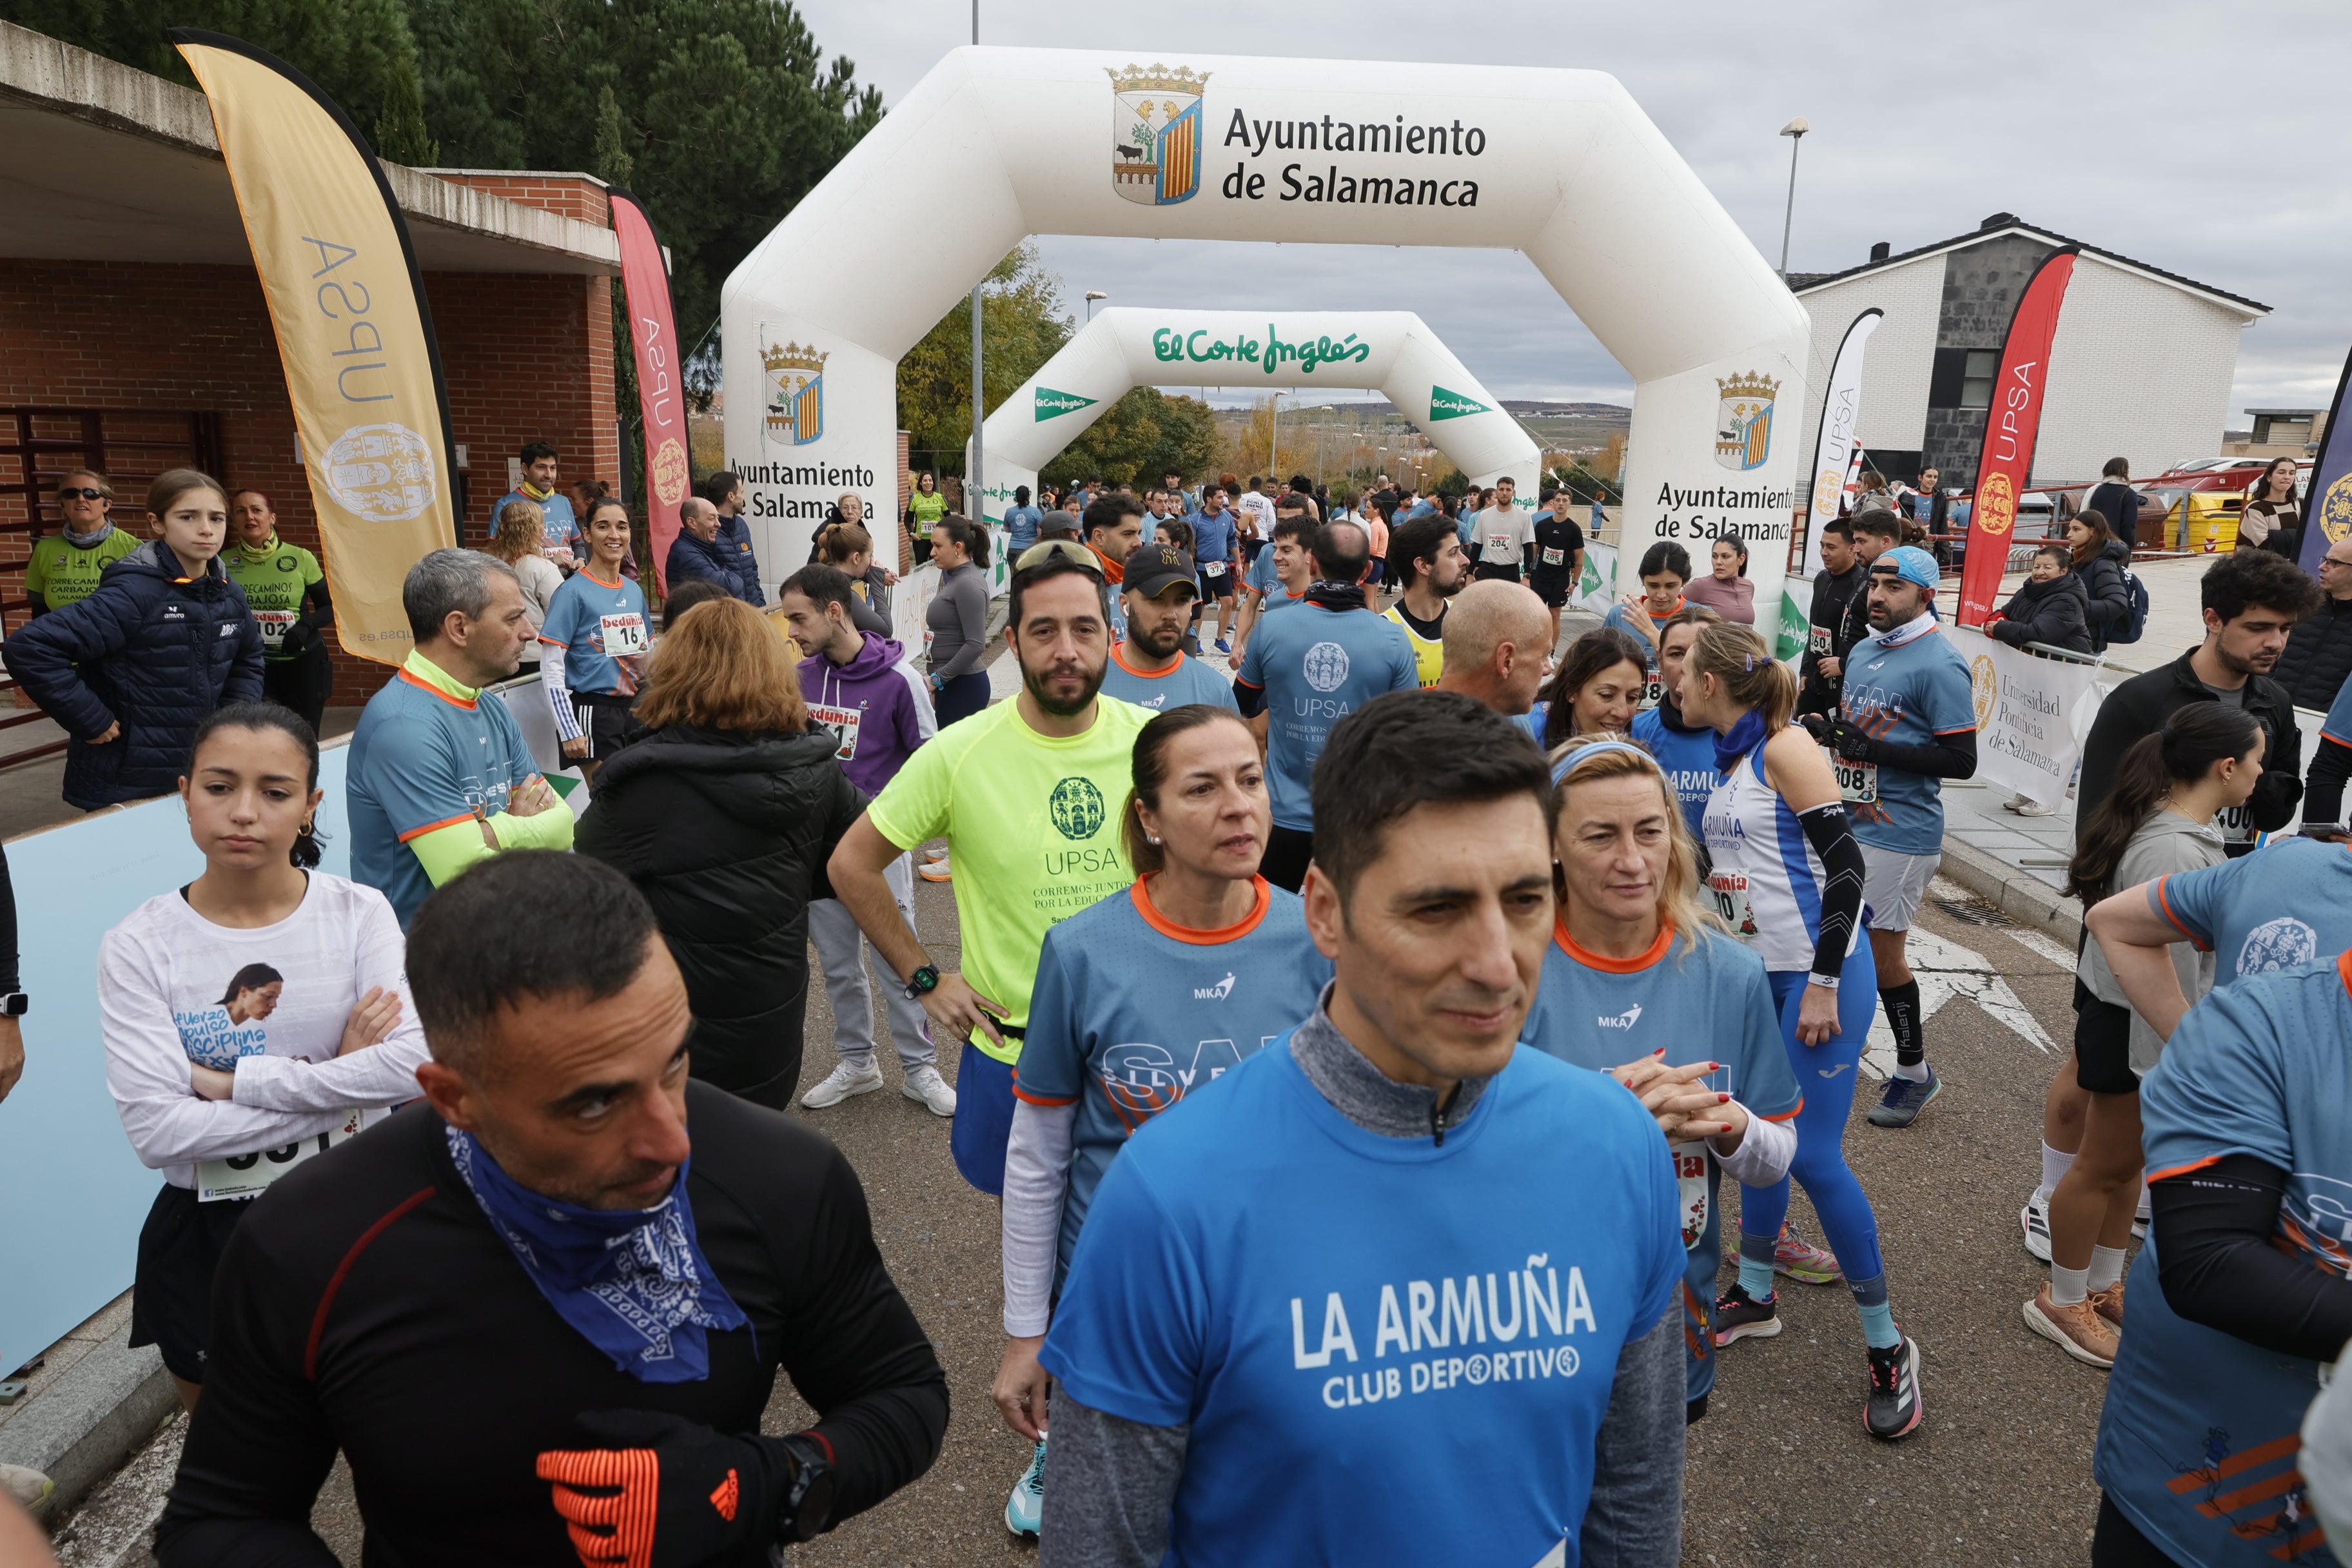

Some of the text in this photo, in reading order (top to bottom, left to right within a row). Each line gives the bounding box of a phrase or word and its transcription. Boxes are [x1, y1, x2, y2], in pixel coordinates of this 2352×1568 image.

[1223, 108, 1487, 157] Ayuntamiento
[1222, 162, 1480, 207] de Salamanca
[1152, 323, 1370, 374] El Corte Inglés
[1035, 396, 1086, 410] El Corte Inglés
[1432, 398, 1482, 413] El Corte Inglés
[1995, 361, 2036, 462] UPSA
[1827, 387, 1855, 463] UPSA
[752, 491, 874, 519] Salamaa
[982, 487, 997, 498] orte
[1657, 482, 1793, 511] Ayuntamiento
[1655, 514, 1790, 540] de Salamanca
[1545, 553, 1560, 562] 205
[247, 594, 290, 604] BAJOSA
[253, 613, 294, 622] edunia
[602, 616, 643, 629] bedunia
[620, 627, 638, 645] 16
[1295, 697, 1349, 719] UPSA
[2002, 674, 2061, 717] Universidad
[1286, 721, 1328, 734] CORREMOS
[1997, 701, 2044, 741] Pontificia
[1286, 730, 1300, 740] POR
[1300, 733, 1309, 742] LA
[1989, 729, 2061, 778] de Salamanca
[1834, 765, 1866, 790] 308
[1703, 811, 1747, 839] ARMUÑA
[1045, 847, 1120, 876] UPSA
[1033, 879, 1133, 897] CORREMOS JUNTOS
[1034, 898, 1056, 909] POR
[1059, 897, 1072, 907] LA
[1194, 987, 1224, 999] MKA
[1598, 1016, 1628, 1029] MKA
[1101, 1067, 1227, 1086] SILVE
[1102, 1035, 1278, 1112] SA
[1291, 1251, 1597, 1369] LA ARMUÑA
[1322, 1344, 1580, 1409] CLUB DEPORTIVO
